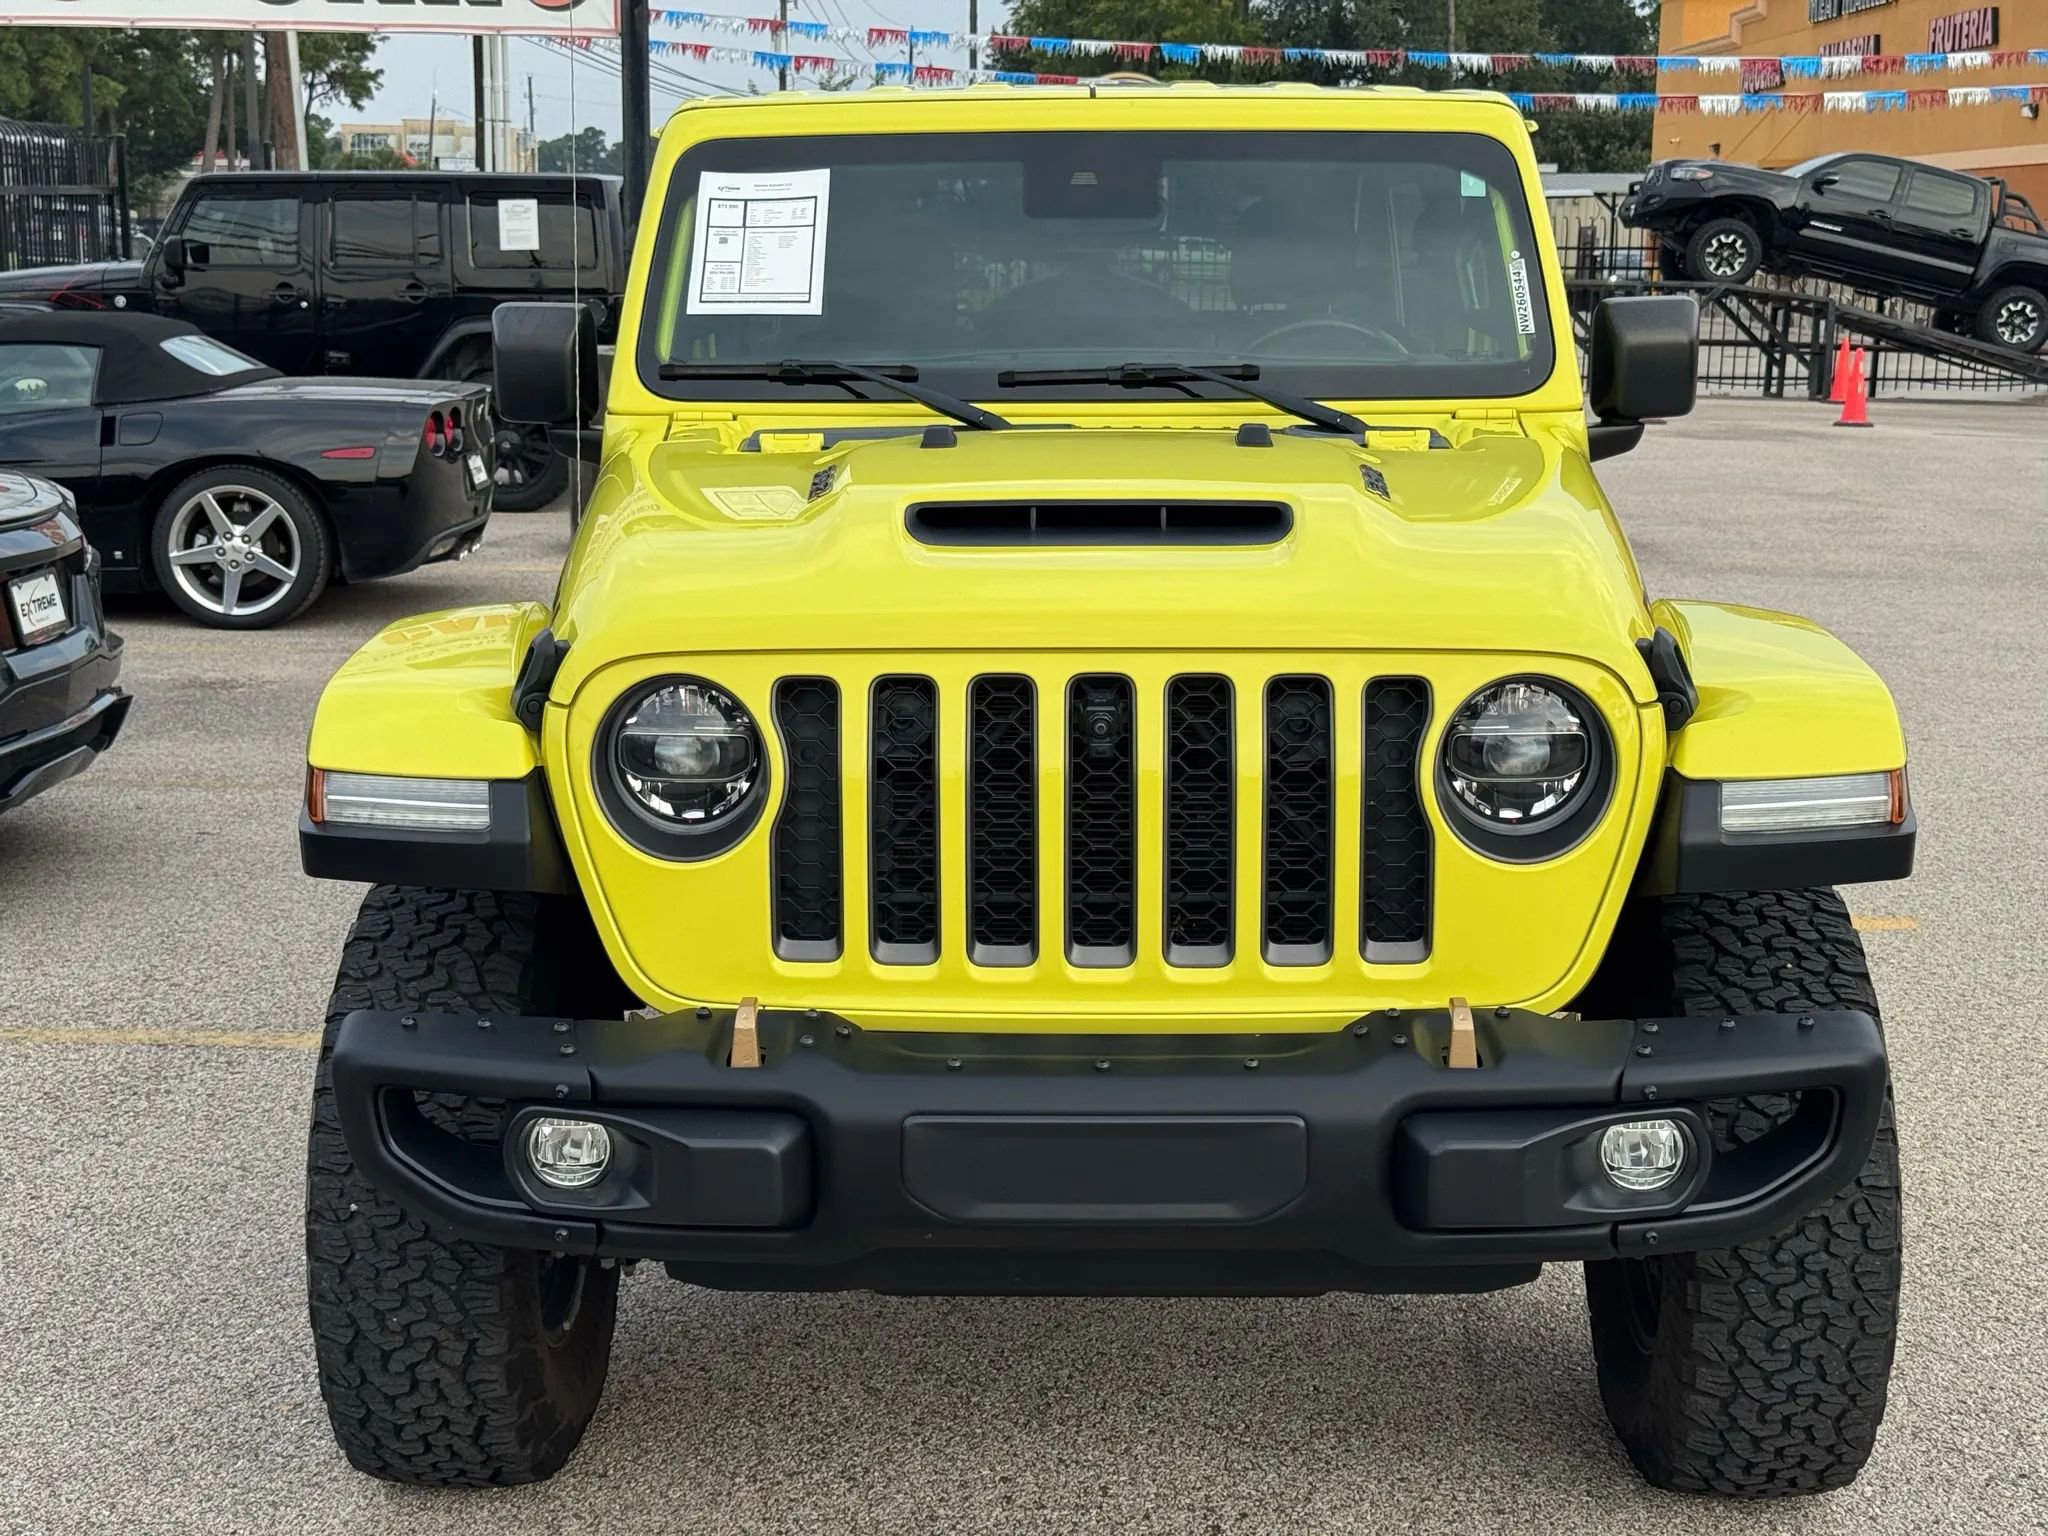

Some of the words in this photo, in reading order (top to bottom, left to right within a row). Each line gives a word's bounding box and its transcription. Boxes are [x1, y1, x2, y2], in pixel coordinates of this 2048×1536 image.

[1928, 7, 1993, 54] FRUTERIA
[1512, 271, 1530, 332] NW260544
[20, 593, 57, 617] EXTREME
